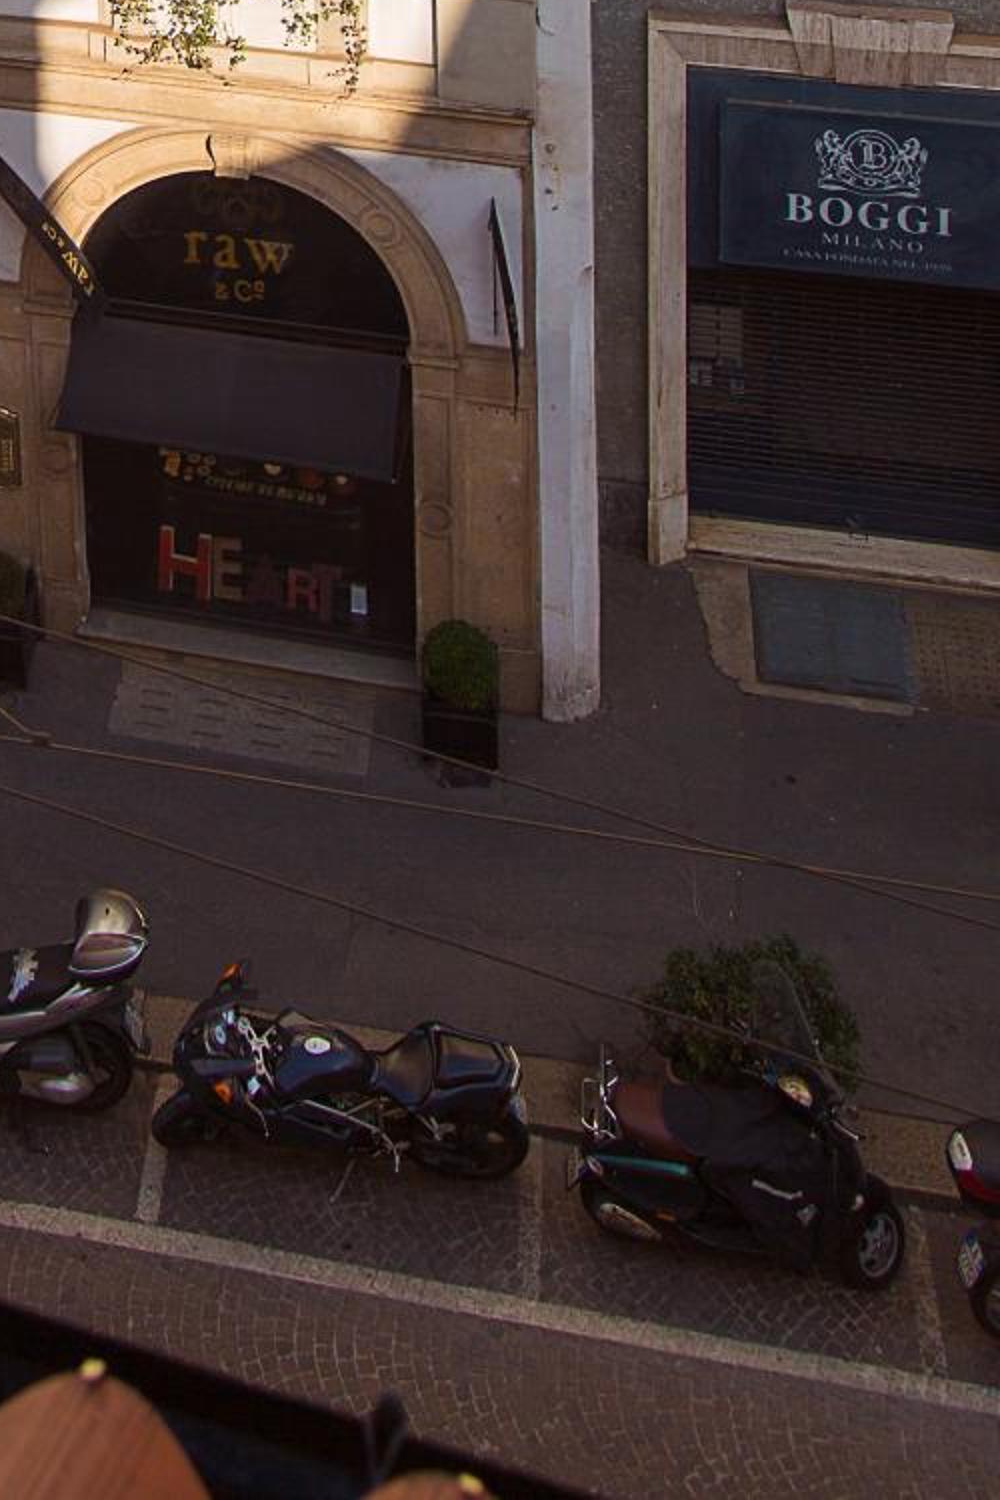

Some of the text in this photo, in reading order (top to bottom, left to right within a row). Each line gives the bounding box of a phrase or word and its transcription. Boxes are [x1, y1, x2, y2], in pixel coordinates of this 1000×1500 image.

[783, 193, 953, 237] BOGGI
[183, 231, 295, 275] raw
[821, 231, 923, 254] MILANO
[61, 251, 95, 297] raw
[157, 525, 343, 622] HEART
